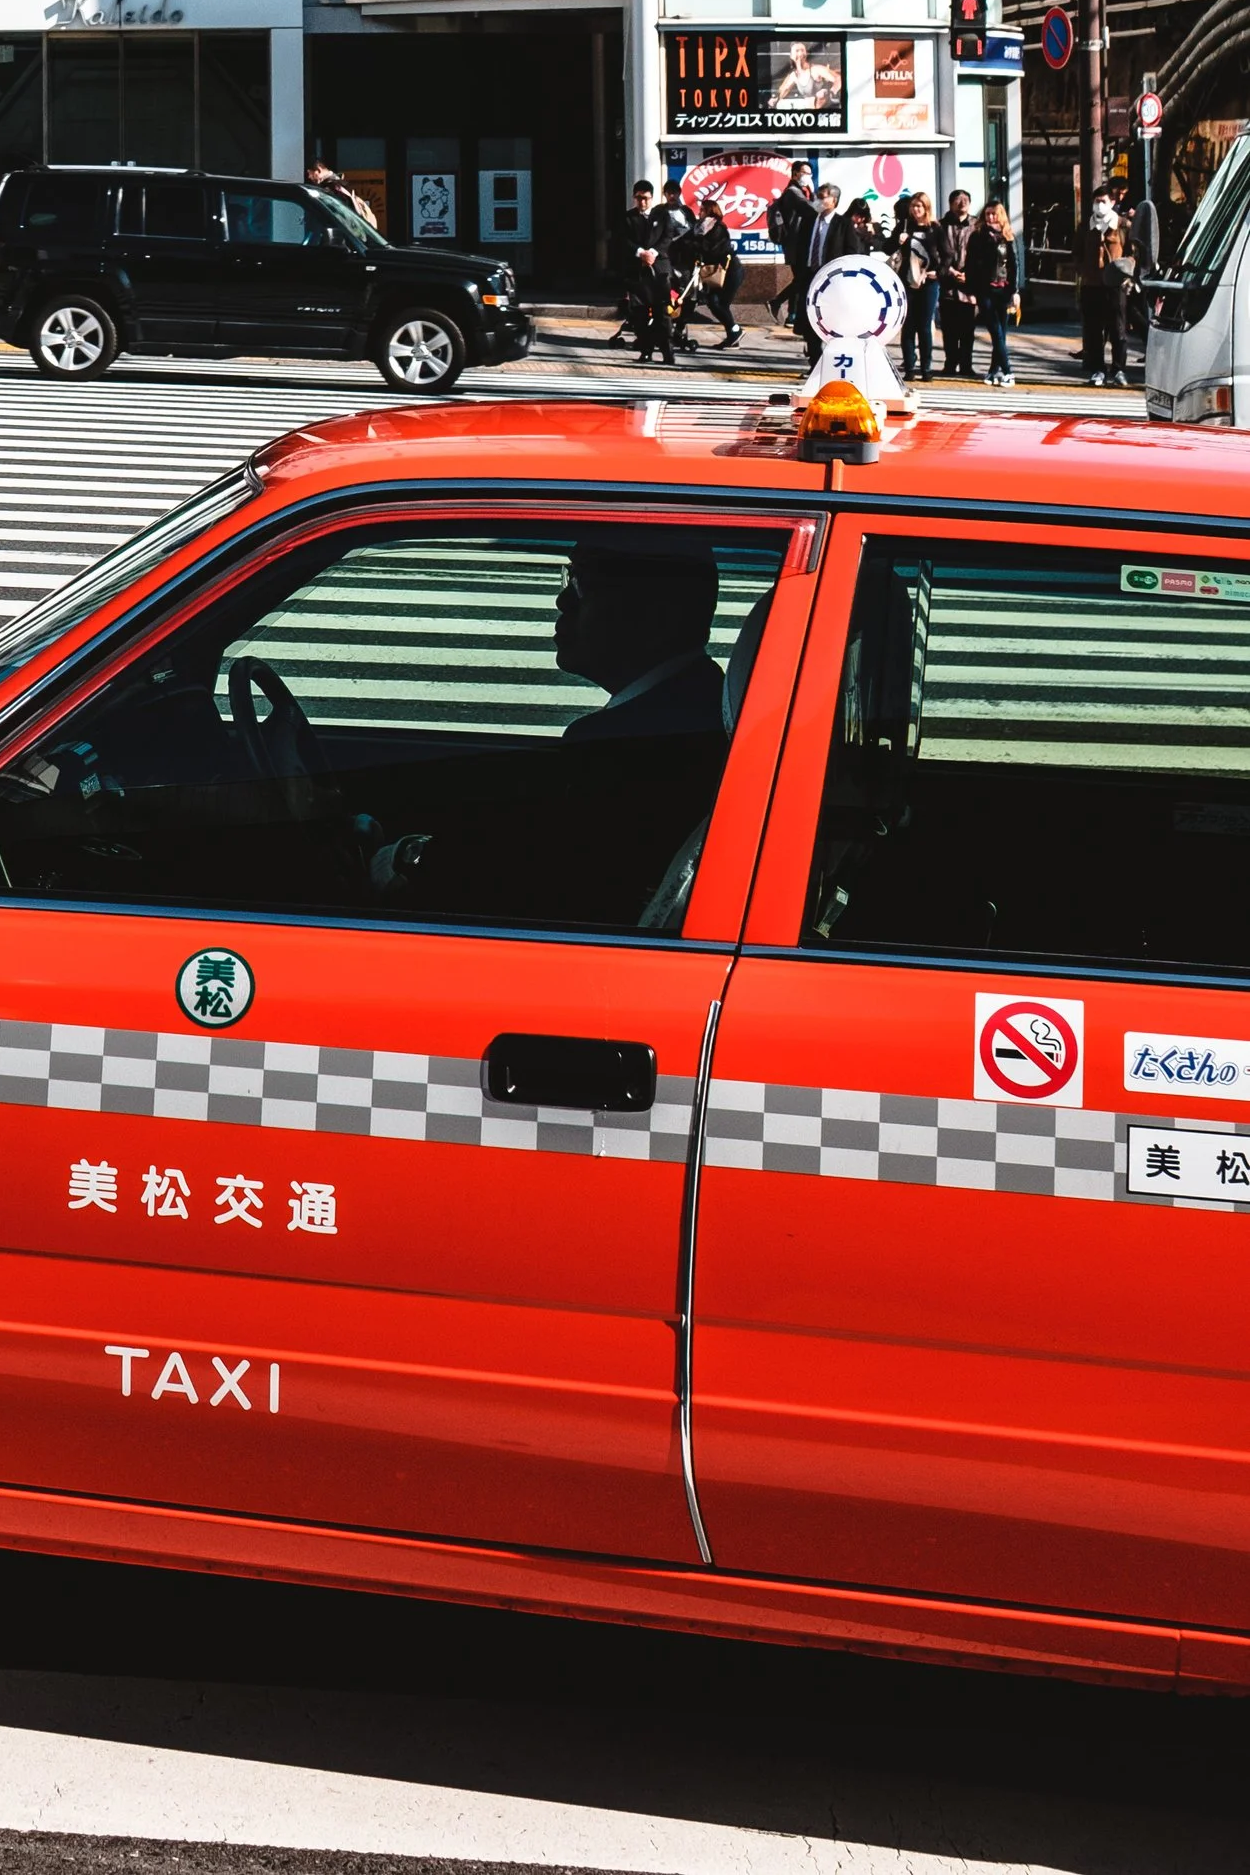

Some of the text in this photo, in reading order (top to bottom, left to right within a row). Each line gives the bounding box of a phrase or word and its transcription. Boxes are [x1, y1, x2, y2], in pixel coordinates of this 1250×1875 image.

[675, 36, 751, 78] TIP.X
[679, 89, 749, 108] TOKYO
[764, 112, 815, 128] TOKYO
[817, 112, 841, 128] 新宿
[671, 150, 685, 160] 3F
[688, 158, 728, 185] COFFEE
[833, 354, 853, 379] カー
[1164, 578, 1193, 587] PASMO
[194, 956, 237, 1018] 美松
[1131, 1046, 1238, 1085] たくさんの
[1146, 1143, 1250, 1185] 美松
[68, 1158, 338, 1235] 美松交通
[104, 1345, 280, 1414] TAXI
